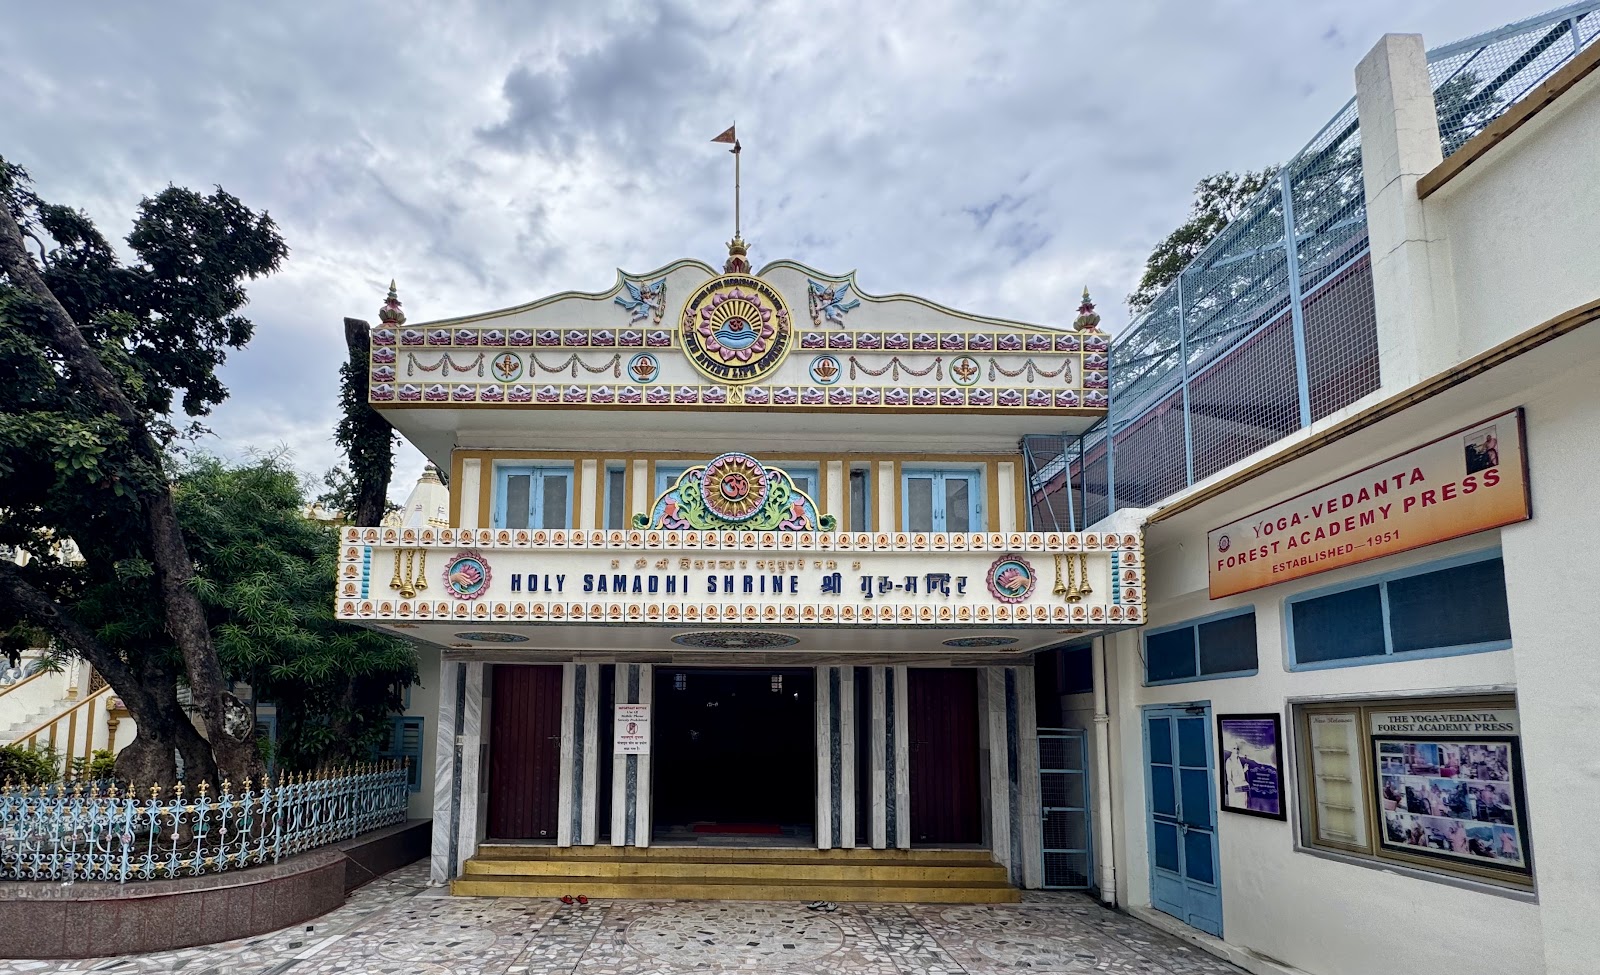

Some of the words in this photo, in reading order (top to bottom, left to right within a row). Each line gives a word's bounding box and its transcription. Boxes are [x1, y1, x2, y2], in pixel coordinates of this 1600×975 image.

[1252, 467, 1425, 539] YOGA-VEDANTA
[1217, 541, 1280, 572] FOREST
[1287, 503, 1393, 550] ACADEMY
[1403, 468, 1500, 513] PRESS
[510, 574, 566, 593] HOLY
[583, 574, 688, 593] SAMADHI
[707, 575, 798, 594] SHRINE
[820, 572, 842, 594] श्री
[1377, 724, 1415, 732] FOREST
[1417, 724, 1472, 732] ACADEMY
[1474, 723, 1514, 732] PRESS
[1387, 715, 1408, 724] THE
[1410, 713, 1498, 723] YOGA-VEDANTA
